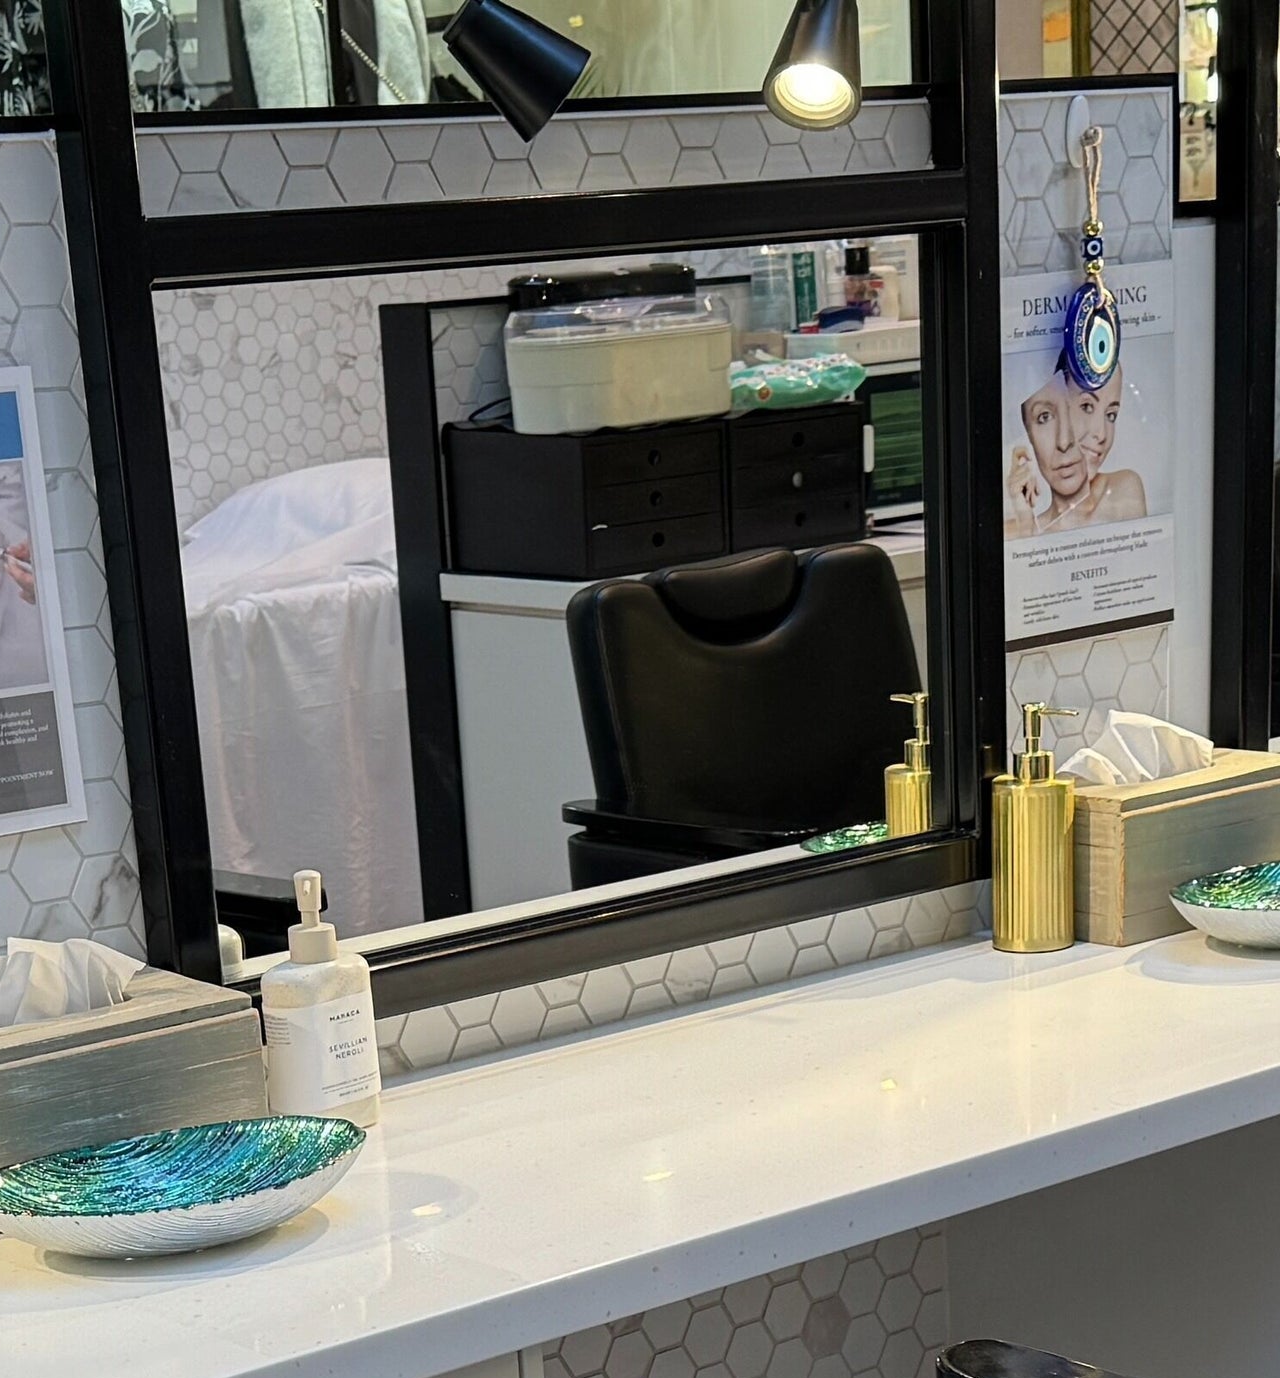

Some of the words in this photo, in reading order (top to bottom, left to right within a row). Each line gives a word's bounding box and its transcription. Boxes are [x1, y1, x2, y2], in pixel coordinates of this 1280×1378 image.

[1023, 286, 1147, 317] DERMING
[1070, 566, 1108, 582] BENEFITS
[329, 1036, 368, 1053] SEVILLIAN
[335, 1047, 364, 1059] NEROLI
